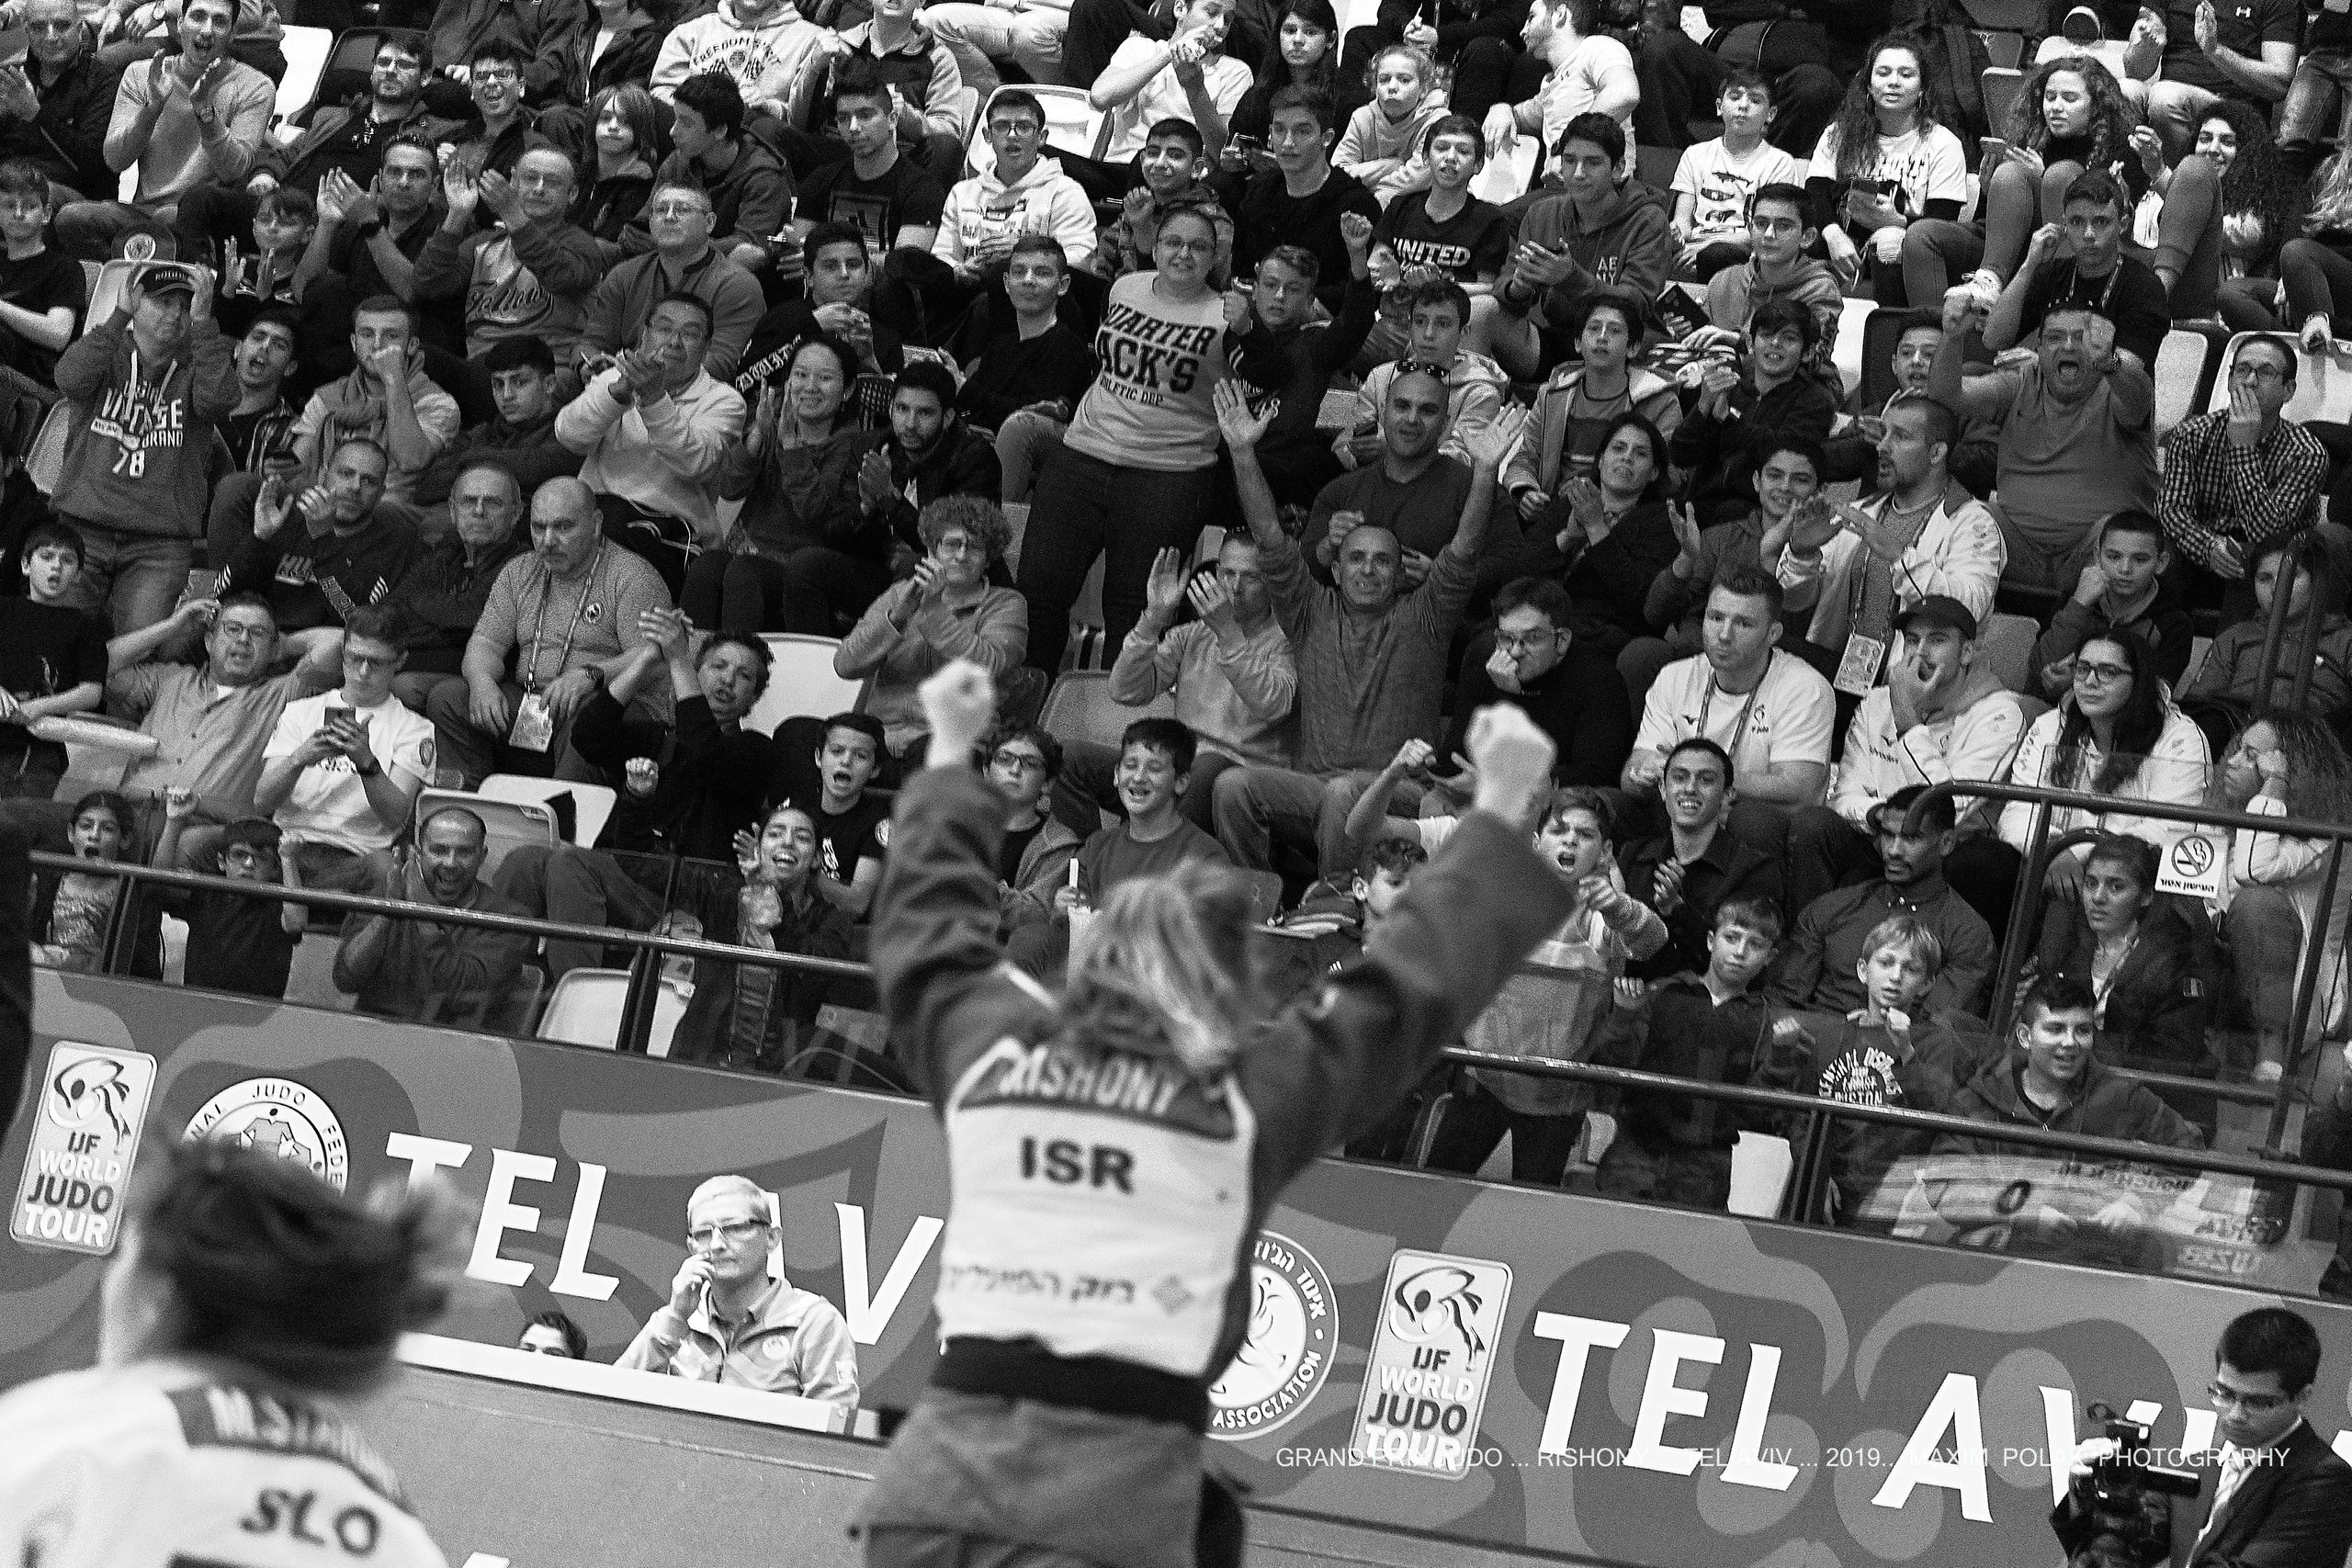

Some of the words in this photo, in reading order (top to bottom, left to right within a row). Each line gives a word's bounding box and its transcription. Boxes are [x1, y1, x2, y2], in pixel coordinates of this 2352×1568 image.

[1099, 331, 1200, 394] ACK'S
[252, 1085, 306, 1106] JUDO
[40, 1148, 121, 1184] WORLD
[1020, 1136, 1135, 1195] ISR
[28, 1174, 114, 1214] JUDO
[385, 1131, 620, 1302] TEL
[25, 1203, 108, 1247] TOUR
[1212, 1349, 1323, 1429] ASSOCIATION
[1380, 1364, 1475, 1403] WORLD
[1532, 1310, 1800, 1492] TEL
[1367, 1393, 1467, 1436] JUDO
[1365, 1424, 1462, 1472] TOUR
[239, 1487, 382, 1557] SLO
